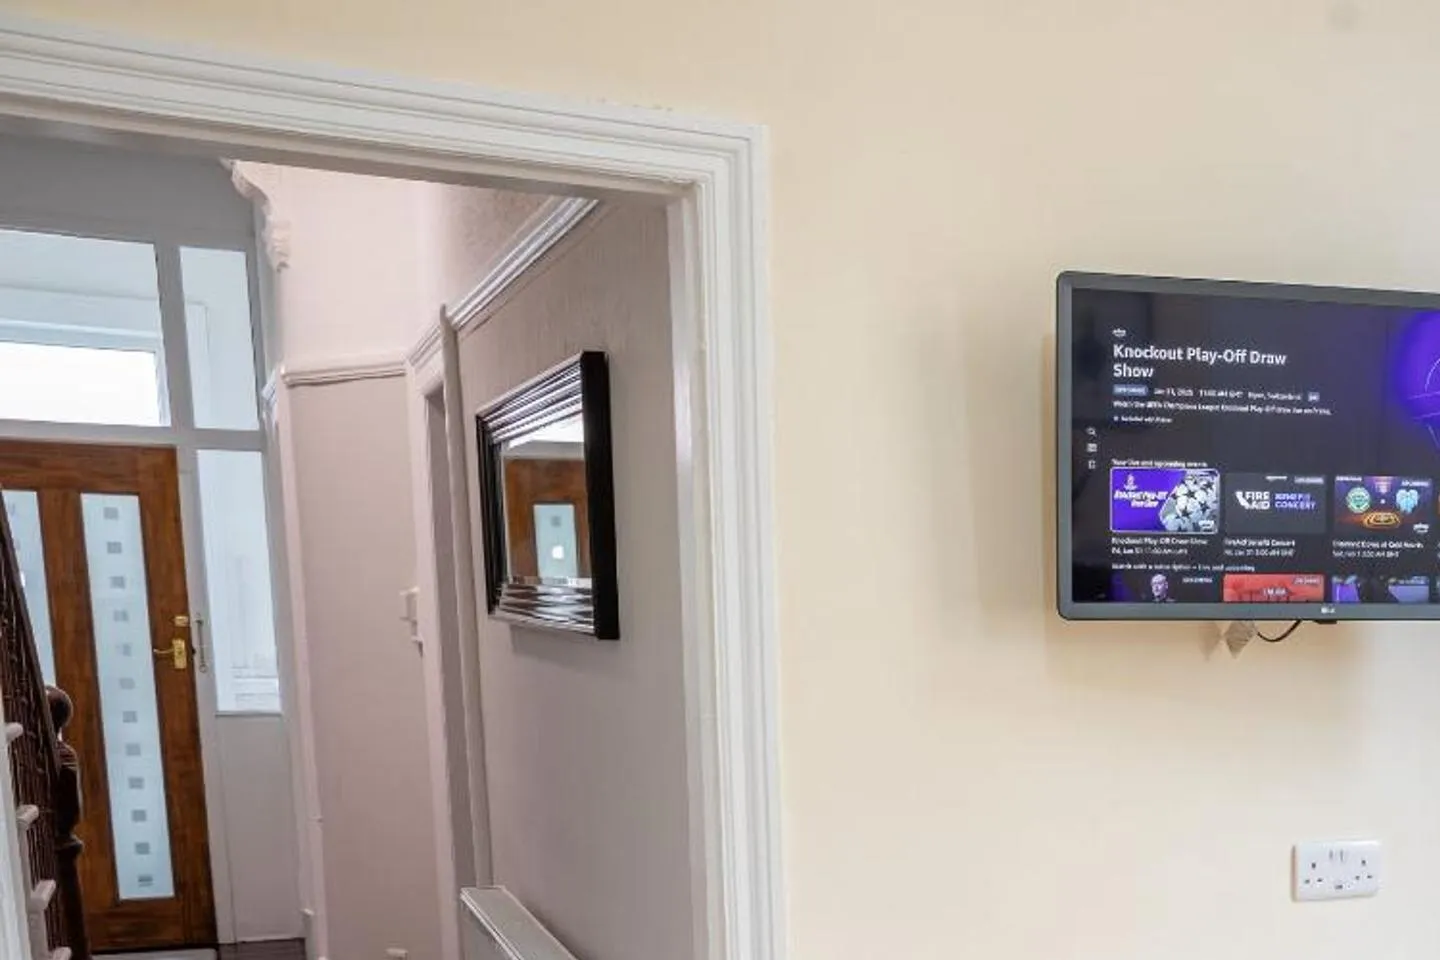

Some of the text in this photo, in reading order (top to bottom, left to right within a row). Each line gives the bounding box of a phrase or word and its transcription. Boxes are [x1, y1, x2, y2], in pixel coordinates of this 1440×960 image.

[1113, 344, 1288, 365] Knockout Play-Off Draw
[1113, 363, 1154, 378] Show
[1245, 491, 1270, 500] FIRE
